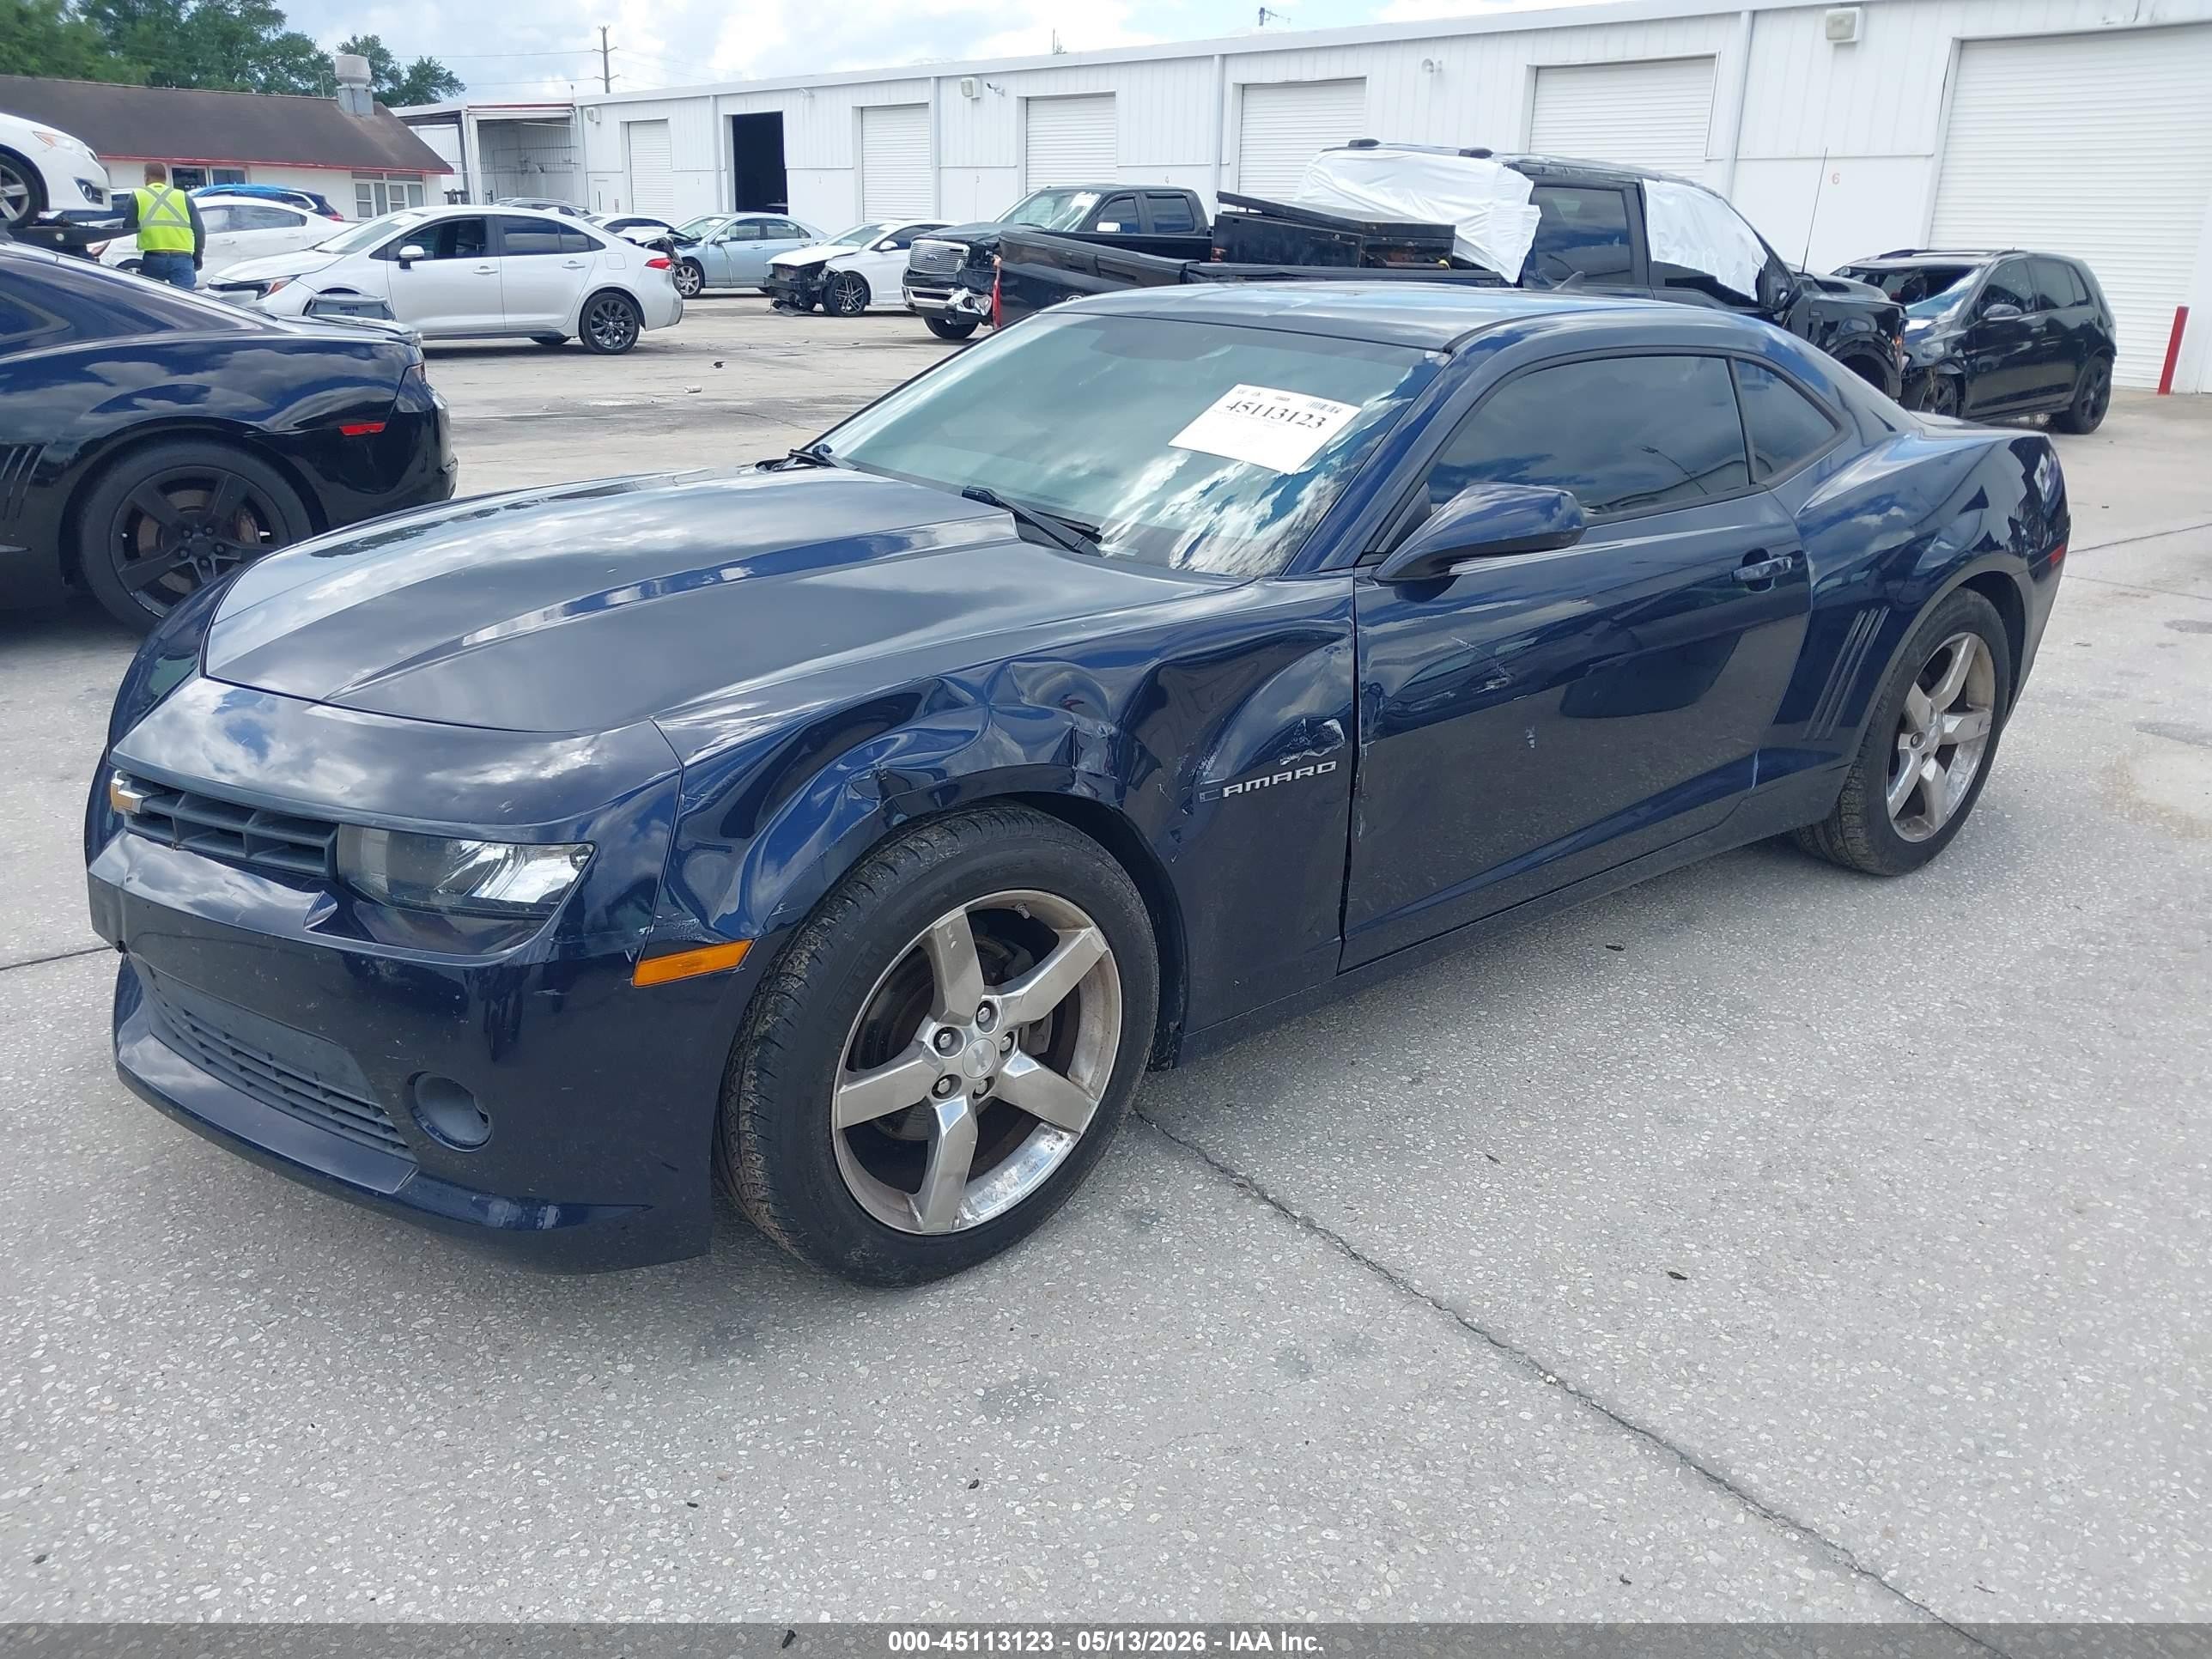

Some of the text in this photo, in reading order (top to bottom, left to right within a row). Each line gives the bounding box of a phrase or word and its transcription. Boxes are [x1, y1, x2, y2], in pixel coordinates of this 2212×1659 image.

[1832, 173, 1840, 185] 6
[1225, 399, 1327, 429] 45113123
[1200, 760, 1337, 803] CAMARO
